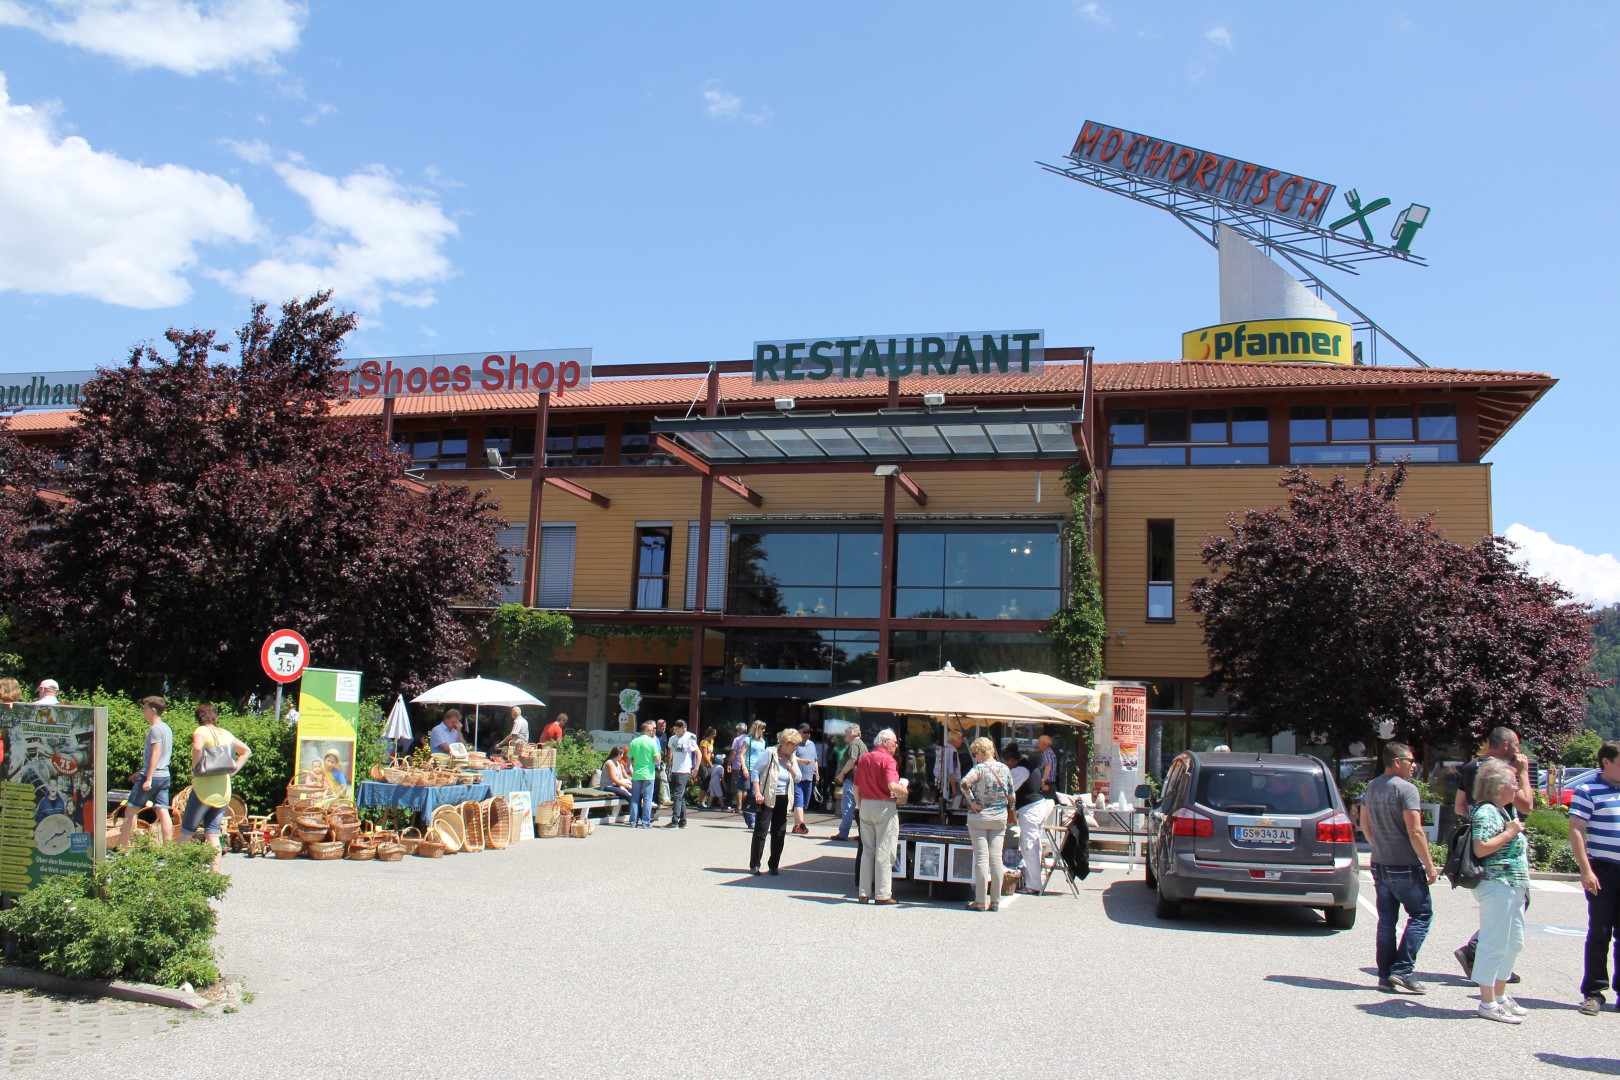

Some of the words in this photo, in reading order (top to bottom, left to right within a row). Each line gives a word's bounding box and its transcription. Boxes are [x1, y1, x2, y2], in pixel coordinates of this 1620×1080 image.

[1073, 121, 1332, 221] MOCHORITSCH
[755, 332, 1040, 382] RESTAURANT
[1214, 324, 1342, 359] pfanner
[358, 360, 473, 396] Shoes
[481, 354, 581, 398] Shop
[1242, 828, 1255, 838] GS
[1260, 829, 1279, 839] 343
[1279, 830, 1291, 840] AL
